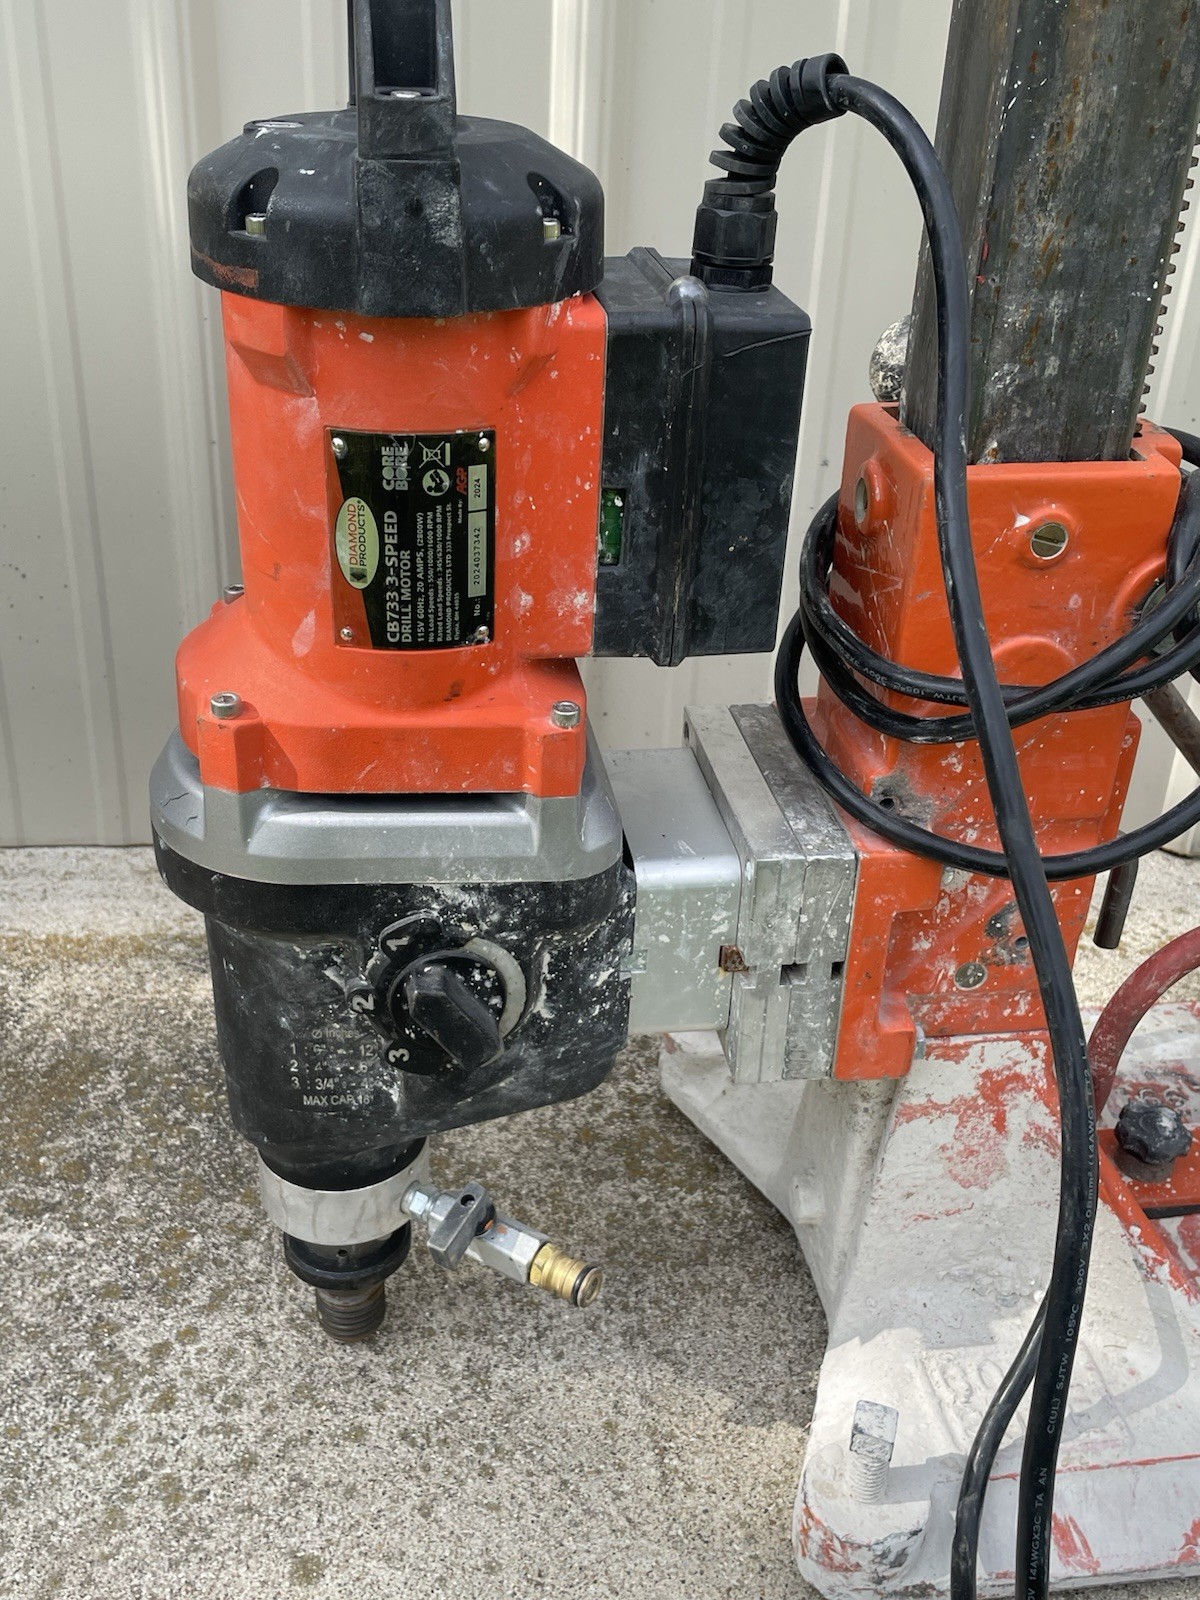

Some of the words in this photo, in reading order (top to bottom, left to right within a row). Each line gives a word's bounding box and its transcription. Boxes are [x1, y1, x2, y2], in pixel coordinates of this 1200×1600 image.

[382, 446, 394, 490] CORE
[456, 467, 467, 494] AGP
[347, 504, 358, 565] DIAMOND
[416, 512, 424, 546] (2800W)
[384, 511, 398, 586] 3-SPEED
[400, 550, 411, 601] MOTOR
[416, 549, 424, 579] AMPS,
[417, 582, 424, 592] 20
[436, 577, 444, 602] Speeds
[386, 591, 399, 642] CB733
[417, 595, 425, 619] 60Hz,
[401, 604, 412, 642] DRILL
[428, 632, 434, 642] No
[386, 936, 410, 951] 1
[352, 994, 375, 1012] 2
[290, 1043, 296, 1054] 1
[388, 1048, 410, 1063] 3
[290, 1060, 298, 1072] 2
[291, 1077, 300, 1089] 3
[315, 1078, 339, 1090] 3/4"
[303, 1095, 327, 1106] MAX
[1046, 1397, 1061, 1434] C(UL)
[1055, 1352, 1069, 1390] SJTW
[1075, 1258, 1087, 1294] 300V
[1038, 1467, 1048, 1485] AN
[1035, 1493, 1045, 1508] TA
[1028, 1516, 1042, 1580] 14AWGX3C
